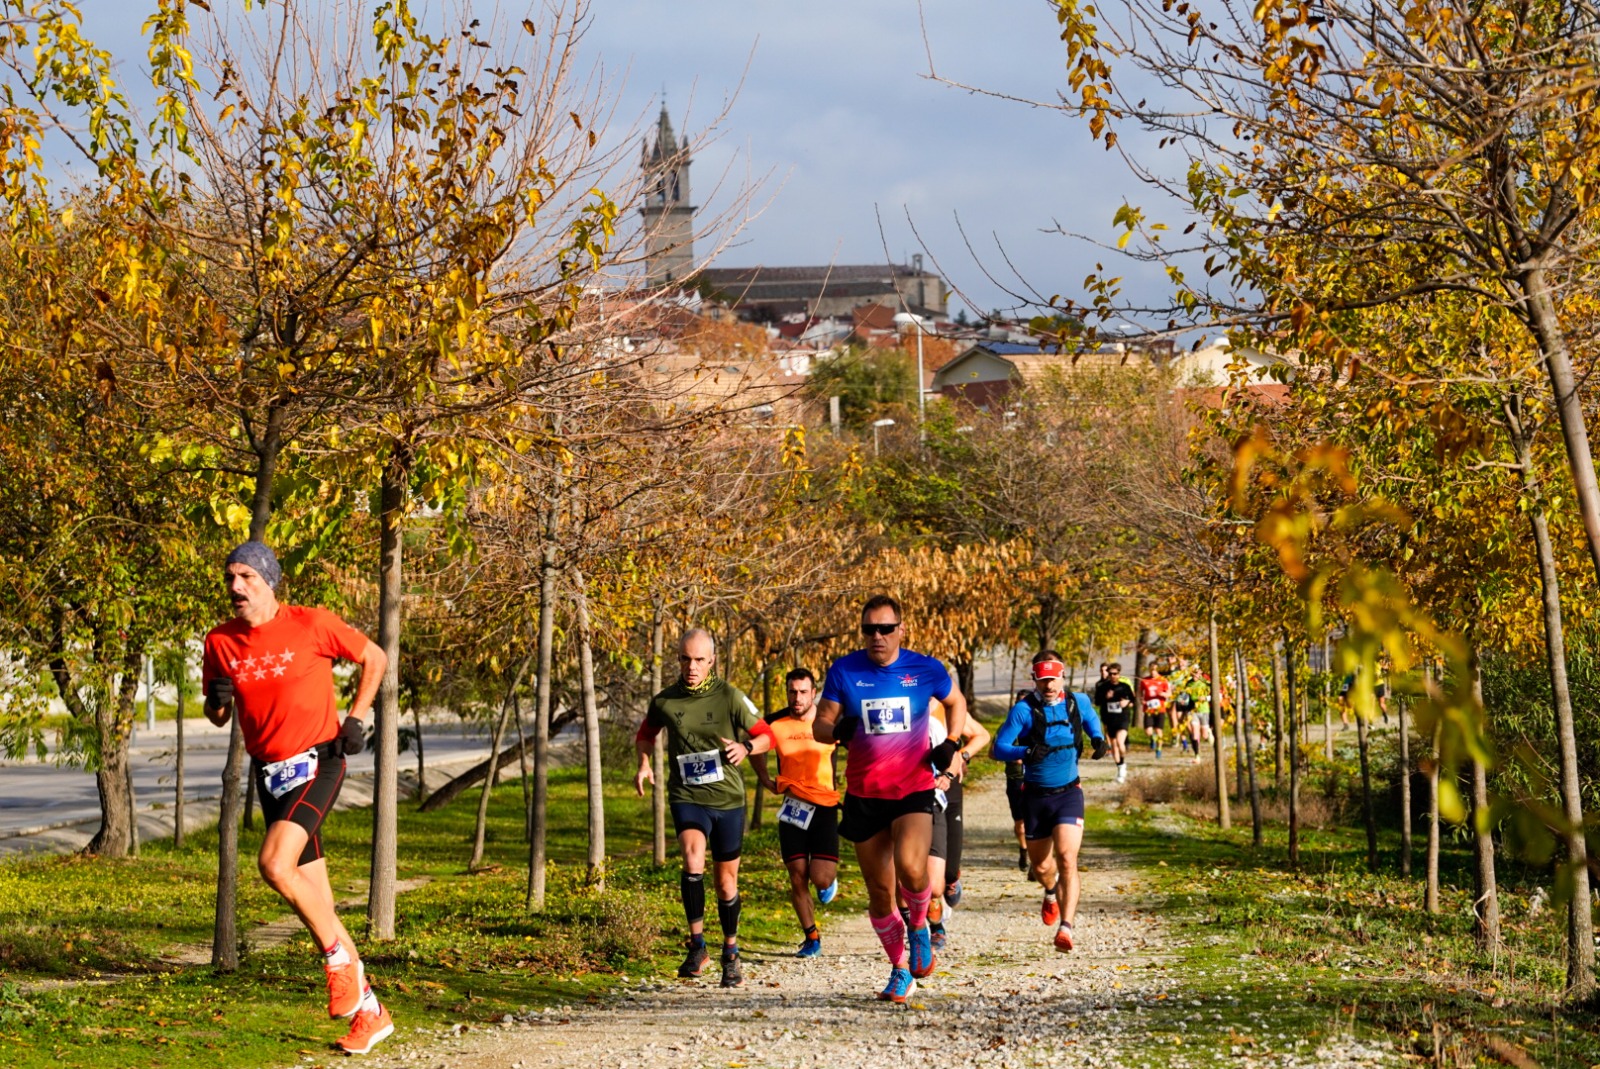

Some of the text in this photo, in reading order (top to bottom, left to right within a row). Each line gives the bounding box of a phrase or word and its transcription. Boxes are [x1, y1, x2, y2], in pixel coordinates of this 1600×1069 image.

[878, 709, 894, 721] 46
[280, 765, 296, 781] 96
[692, 762, 707, 773] 22
